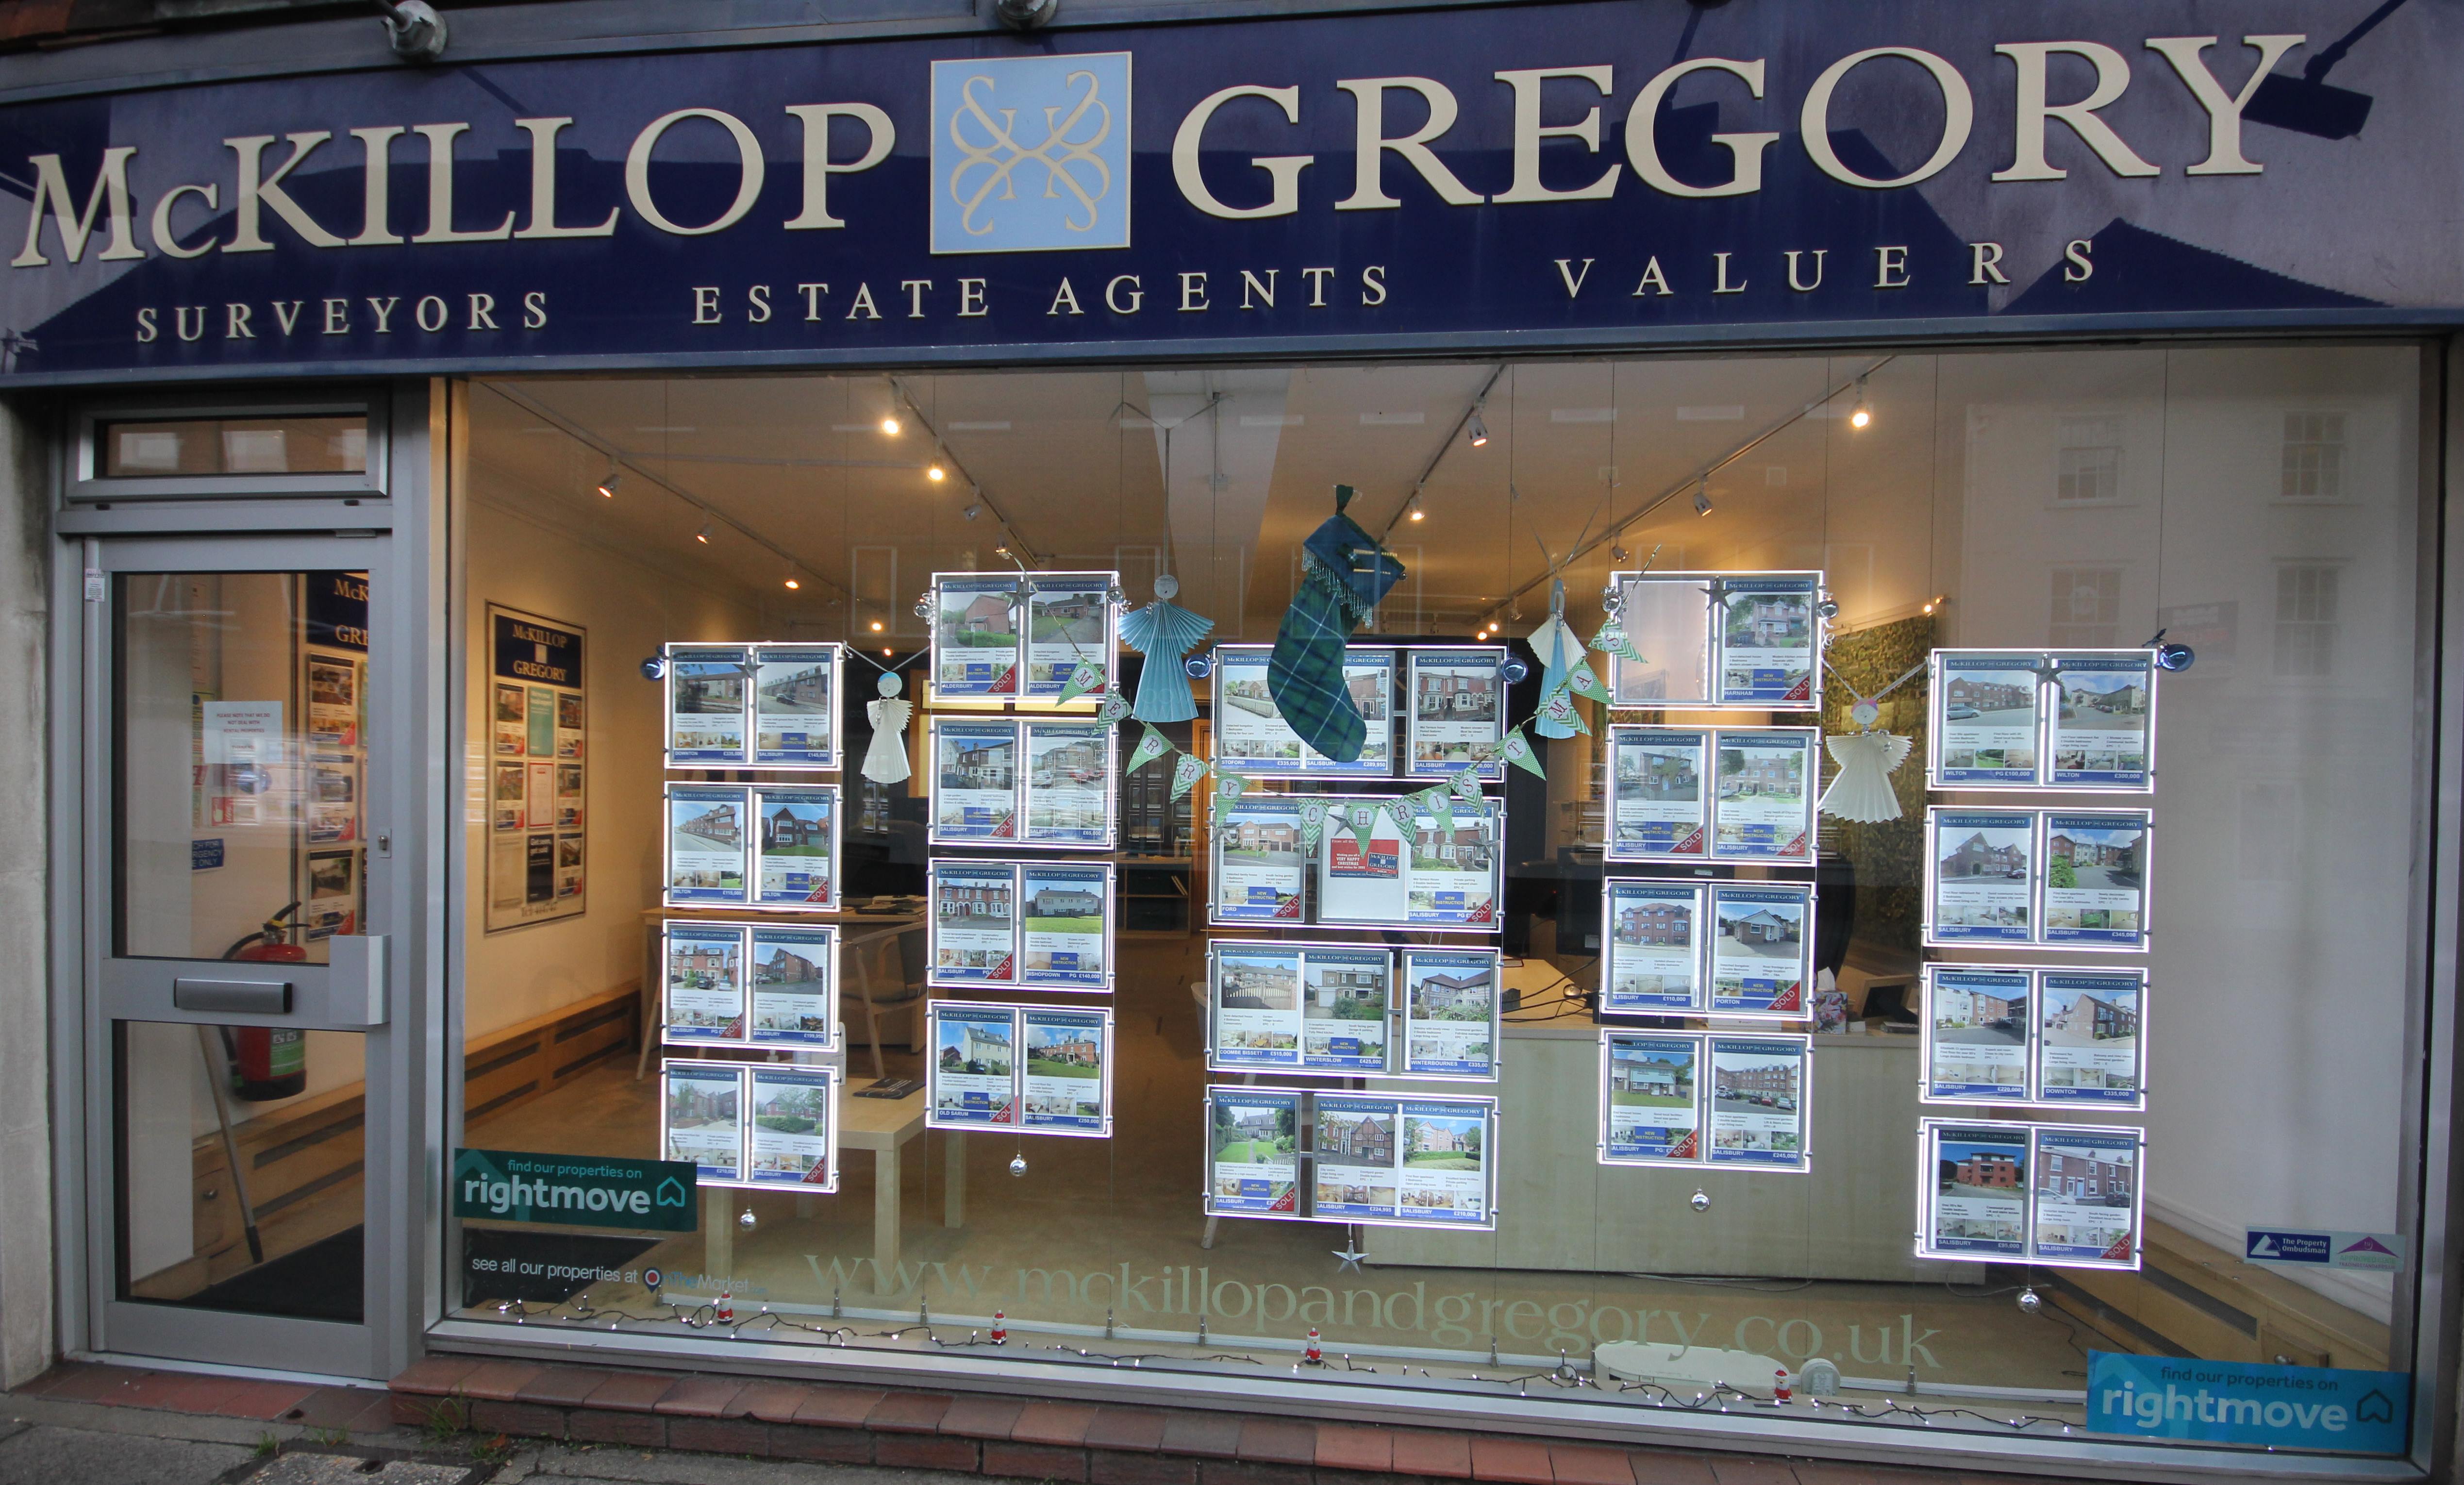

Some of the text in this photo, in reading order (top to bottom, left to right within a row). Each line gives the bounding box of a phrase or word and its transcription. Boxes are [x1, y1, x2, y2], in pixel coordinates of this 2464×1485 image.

[11, 33, 2307, 268] McKILLOP GREGORY
[136, 239, 2094, 344] SURVEYORS ESTATE AGENTS VALUERS
[513, 624, 568, 648] McKILLOP
[513, 660, 567, 681] GREGORY
[993, 673, 1011, 692] SOLD
[1789, 680, 1810, 700] SOLD
[996, 818, 1013, 836] SOLD
[1681, 833, 1701, 851] SOLD
[1785, 836, 1805, 855] SOLD
[812, 884, 828, 901] SOLD
[1281, 898, 1299, 917] SOLD
[1472, 903, 1491, 922] SOLD
[993, 960, 1010, 978] SOLD
[1775, 990, 1795, 1010] SOLD
[725, 1019, 741, 1037] SOLD
[1674, 1137, 1693, 1157] SOLD
[508, 1160, 642, 1179] find our properties on
[807, 1164, 824, 1182] SOLD
[465, 1173, 650, 1214] rightmove
[1276, 1192, 1294, 1210] SOLD
[2109, 1238, 2129, 1258] SOLD
[472, 1258, 497, 1271] see
[502, 1259, 516, 1272] all
[520, 1261, 544, 1275] our
[548, 1265, 620, 1282] properties
[625, 1270, 637, 1283] at
[2161, 1367, 2338, 1391] find our properties on
[2103, 1382, 2347, 1431] rightmove
